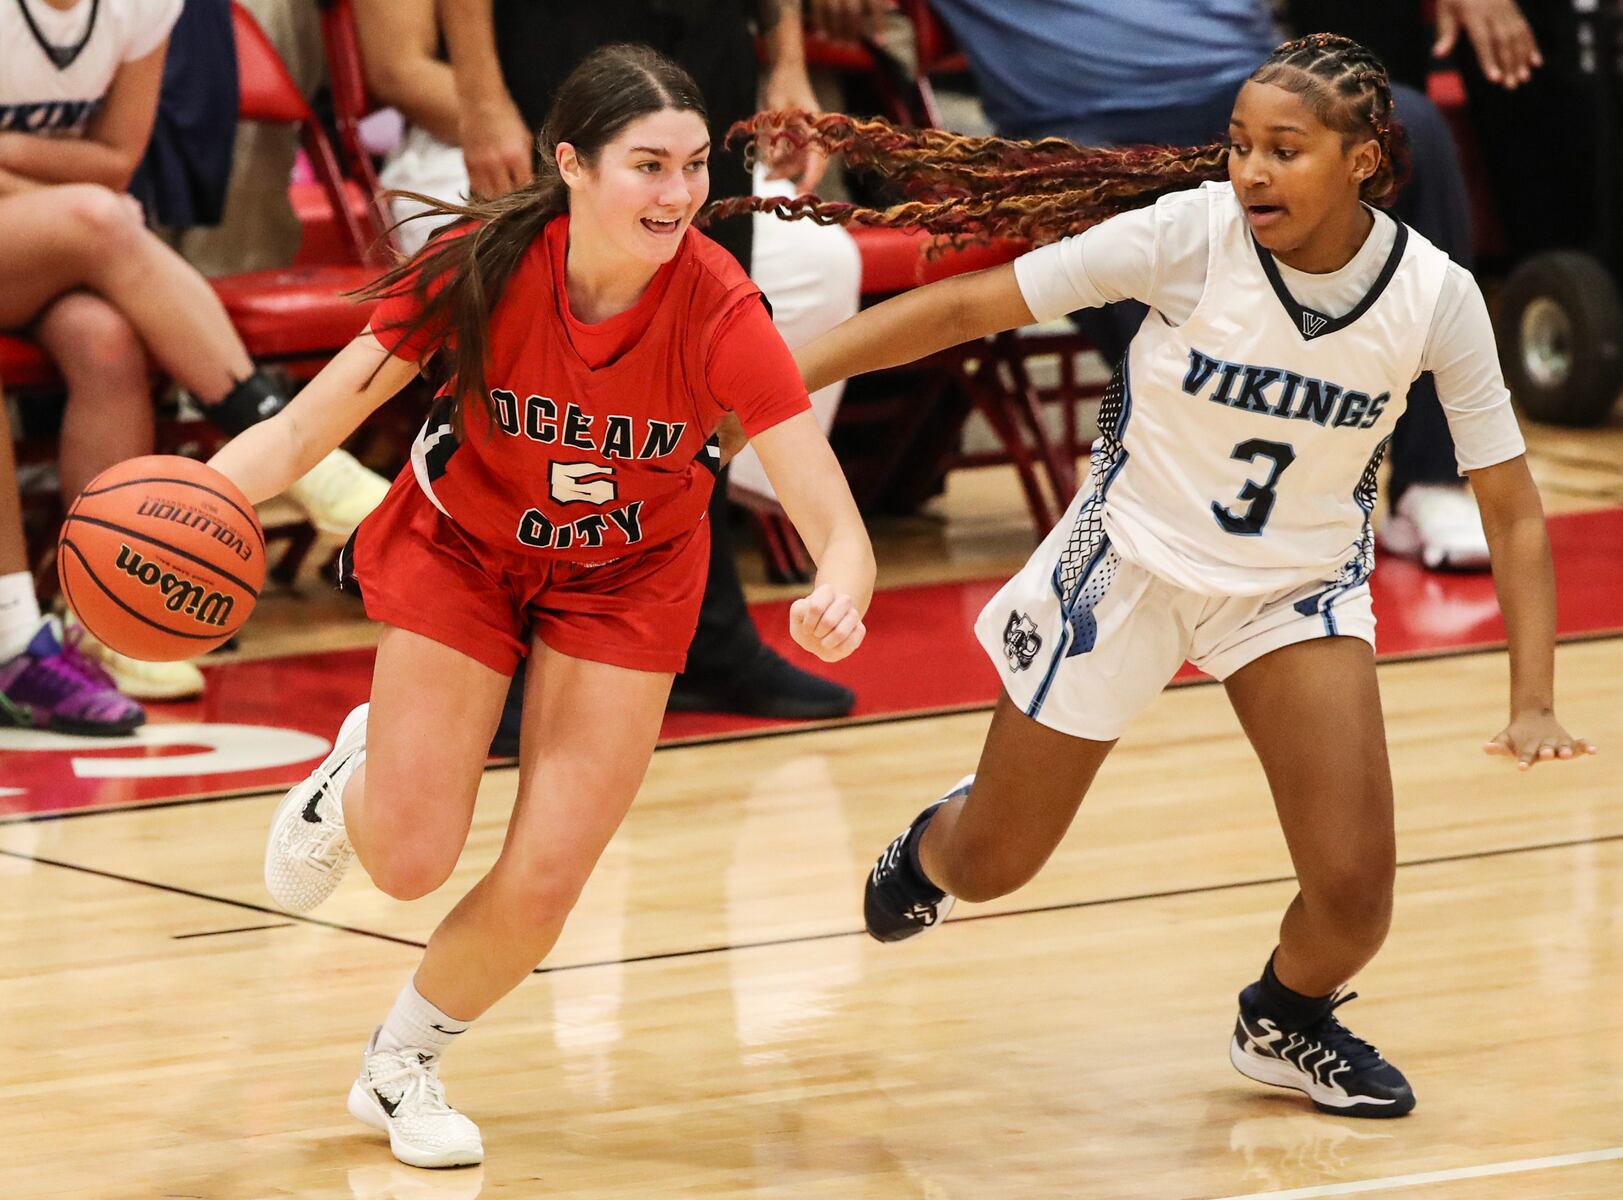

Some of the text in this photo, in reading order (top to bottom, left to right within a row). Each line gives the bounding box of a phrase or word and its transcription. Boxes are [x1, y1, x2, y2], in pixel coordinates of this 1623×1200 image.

[490, 388, 687, 460] OCEAN
[1182, 348, 1391, 429] VIKINGS
[1210, 435, 1296, 537] 3
[136, 500, 252, 562] EVOLUTION
[115, 544, 235, 627] Wilson
